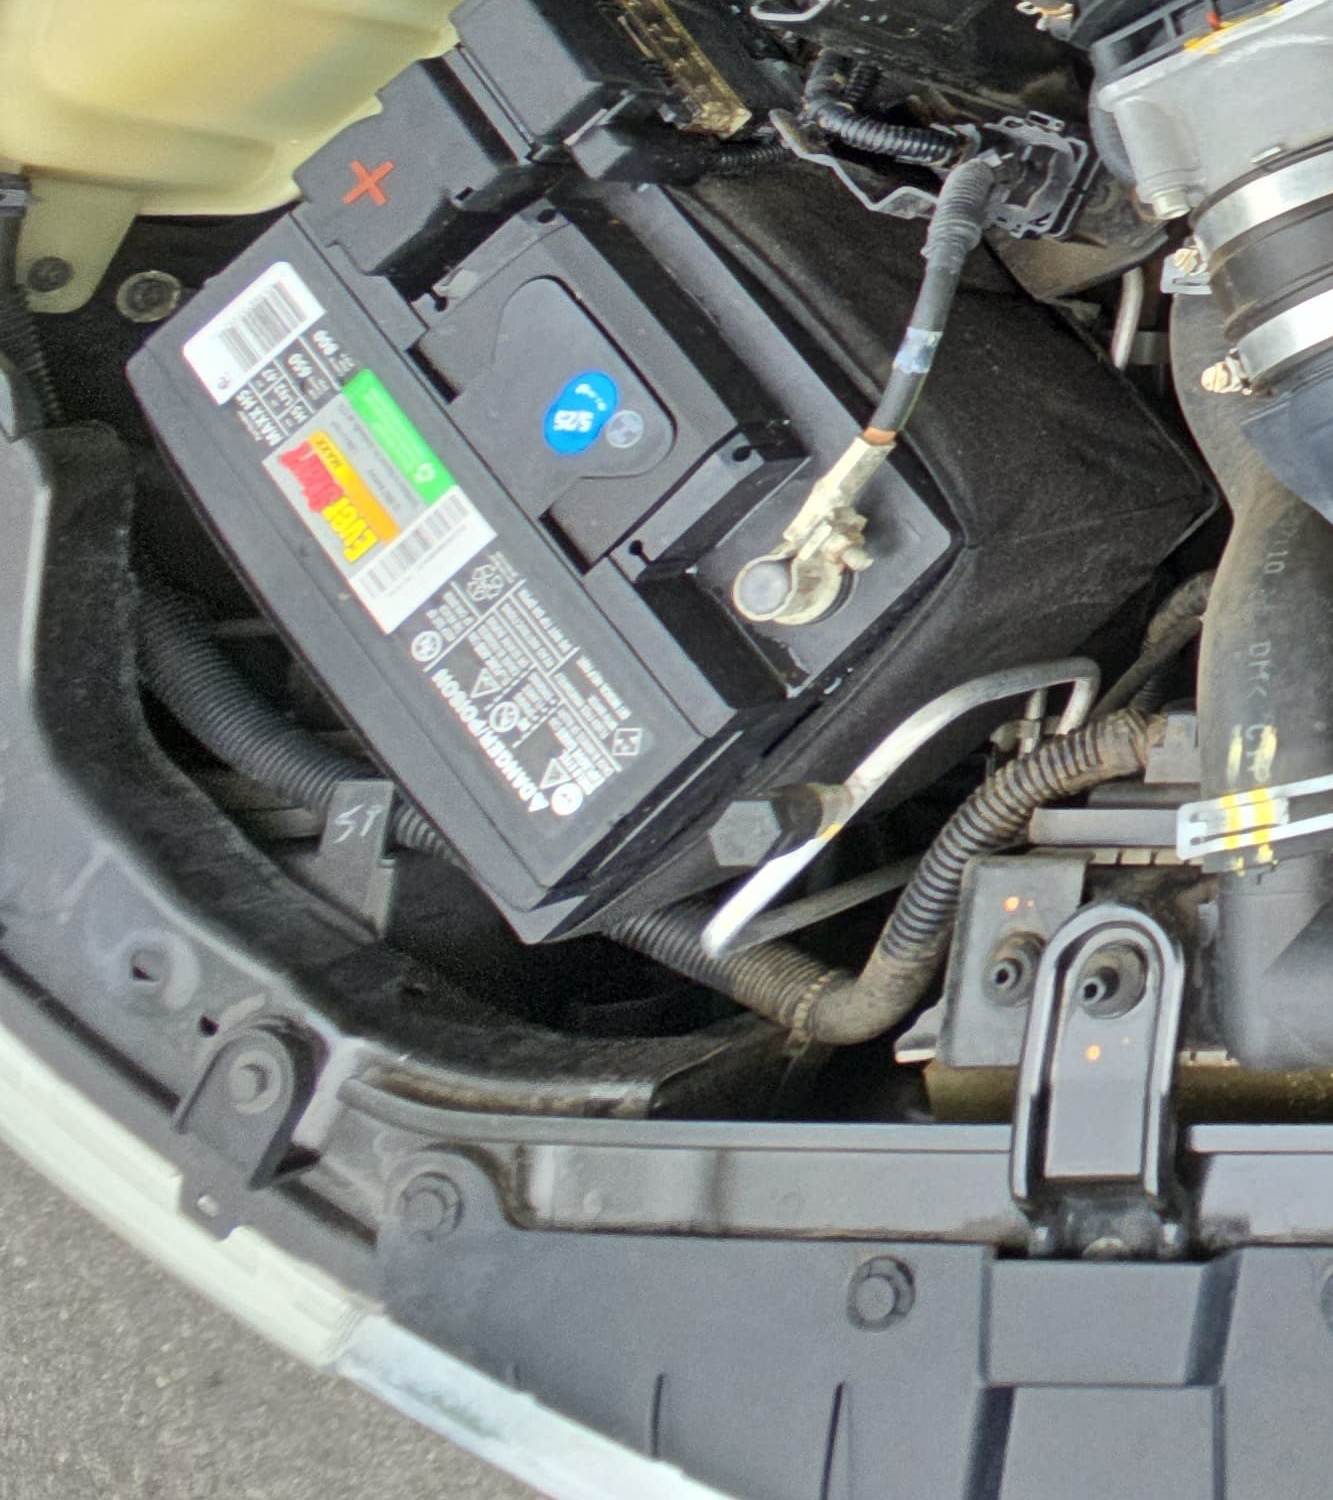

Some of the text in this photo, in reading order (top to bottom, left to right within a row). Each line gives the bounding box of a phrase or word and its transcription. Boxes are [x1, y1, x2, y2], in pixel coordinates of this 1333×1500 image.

[245, 402, 284, 447] MAXX
[314, 436, 343, 470] MAXX
[271, 437, 381, 565] EverStart
